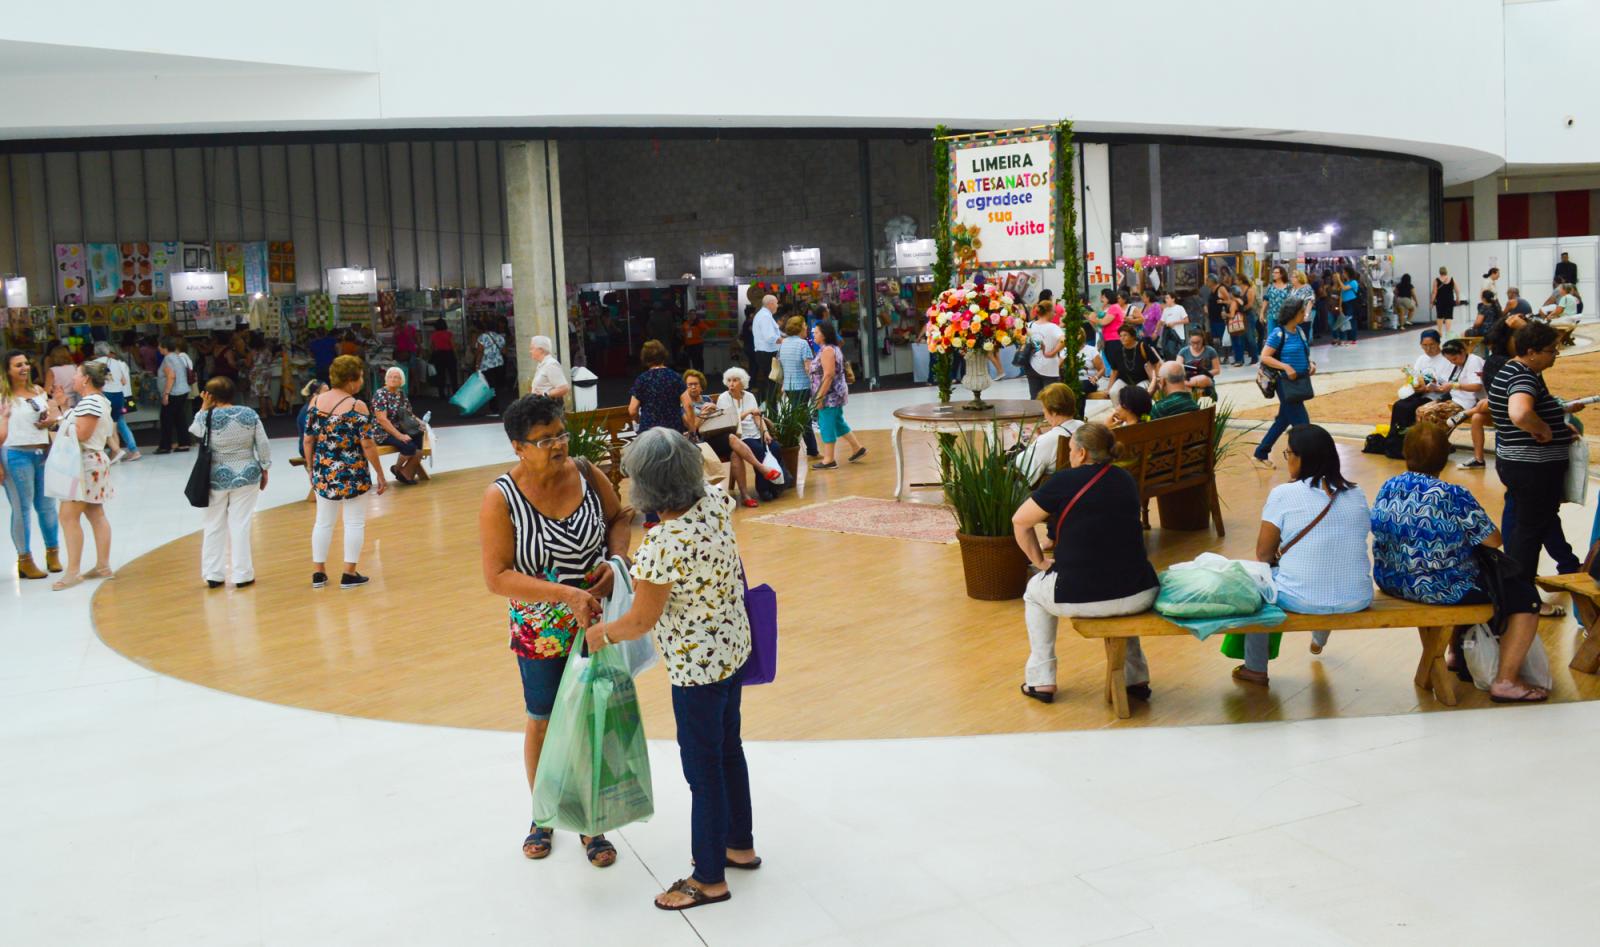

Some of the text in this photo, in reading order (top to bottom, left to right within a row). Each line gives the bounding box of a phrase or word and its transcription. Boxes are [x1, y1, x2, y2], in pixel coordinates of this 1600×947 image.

[972, 153, 1033, 173] LIMEIRA
[957, 172, 1048, 194] ARTESANATOS
[966, 192, 1033, 211] agradece
[988, 211, 1013, 223] sua
[1006, 220, 1045, 236] visita
